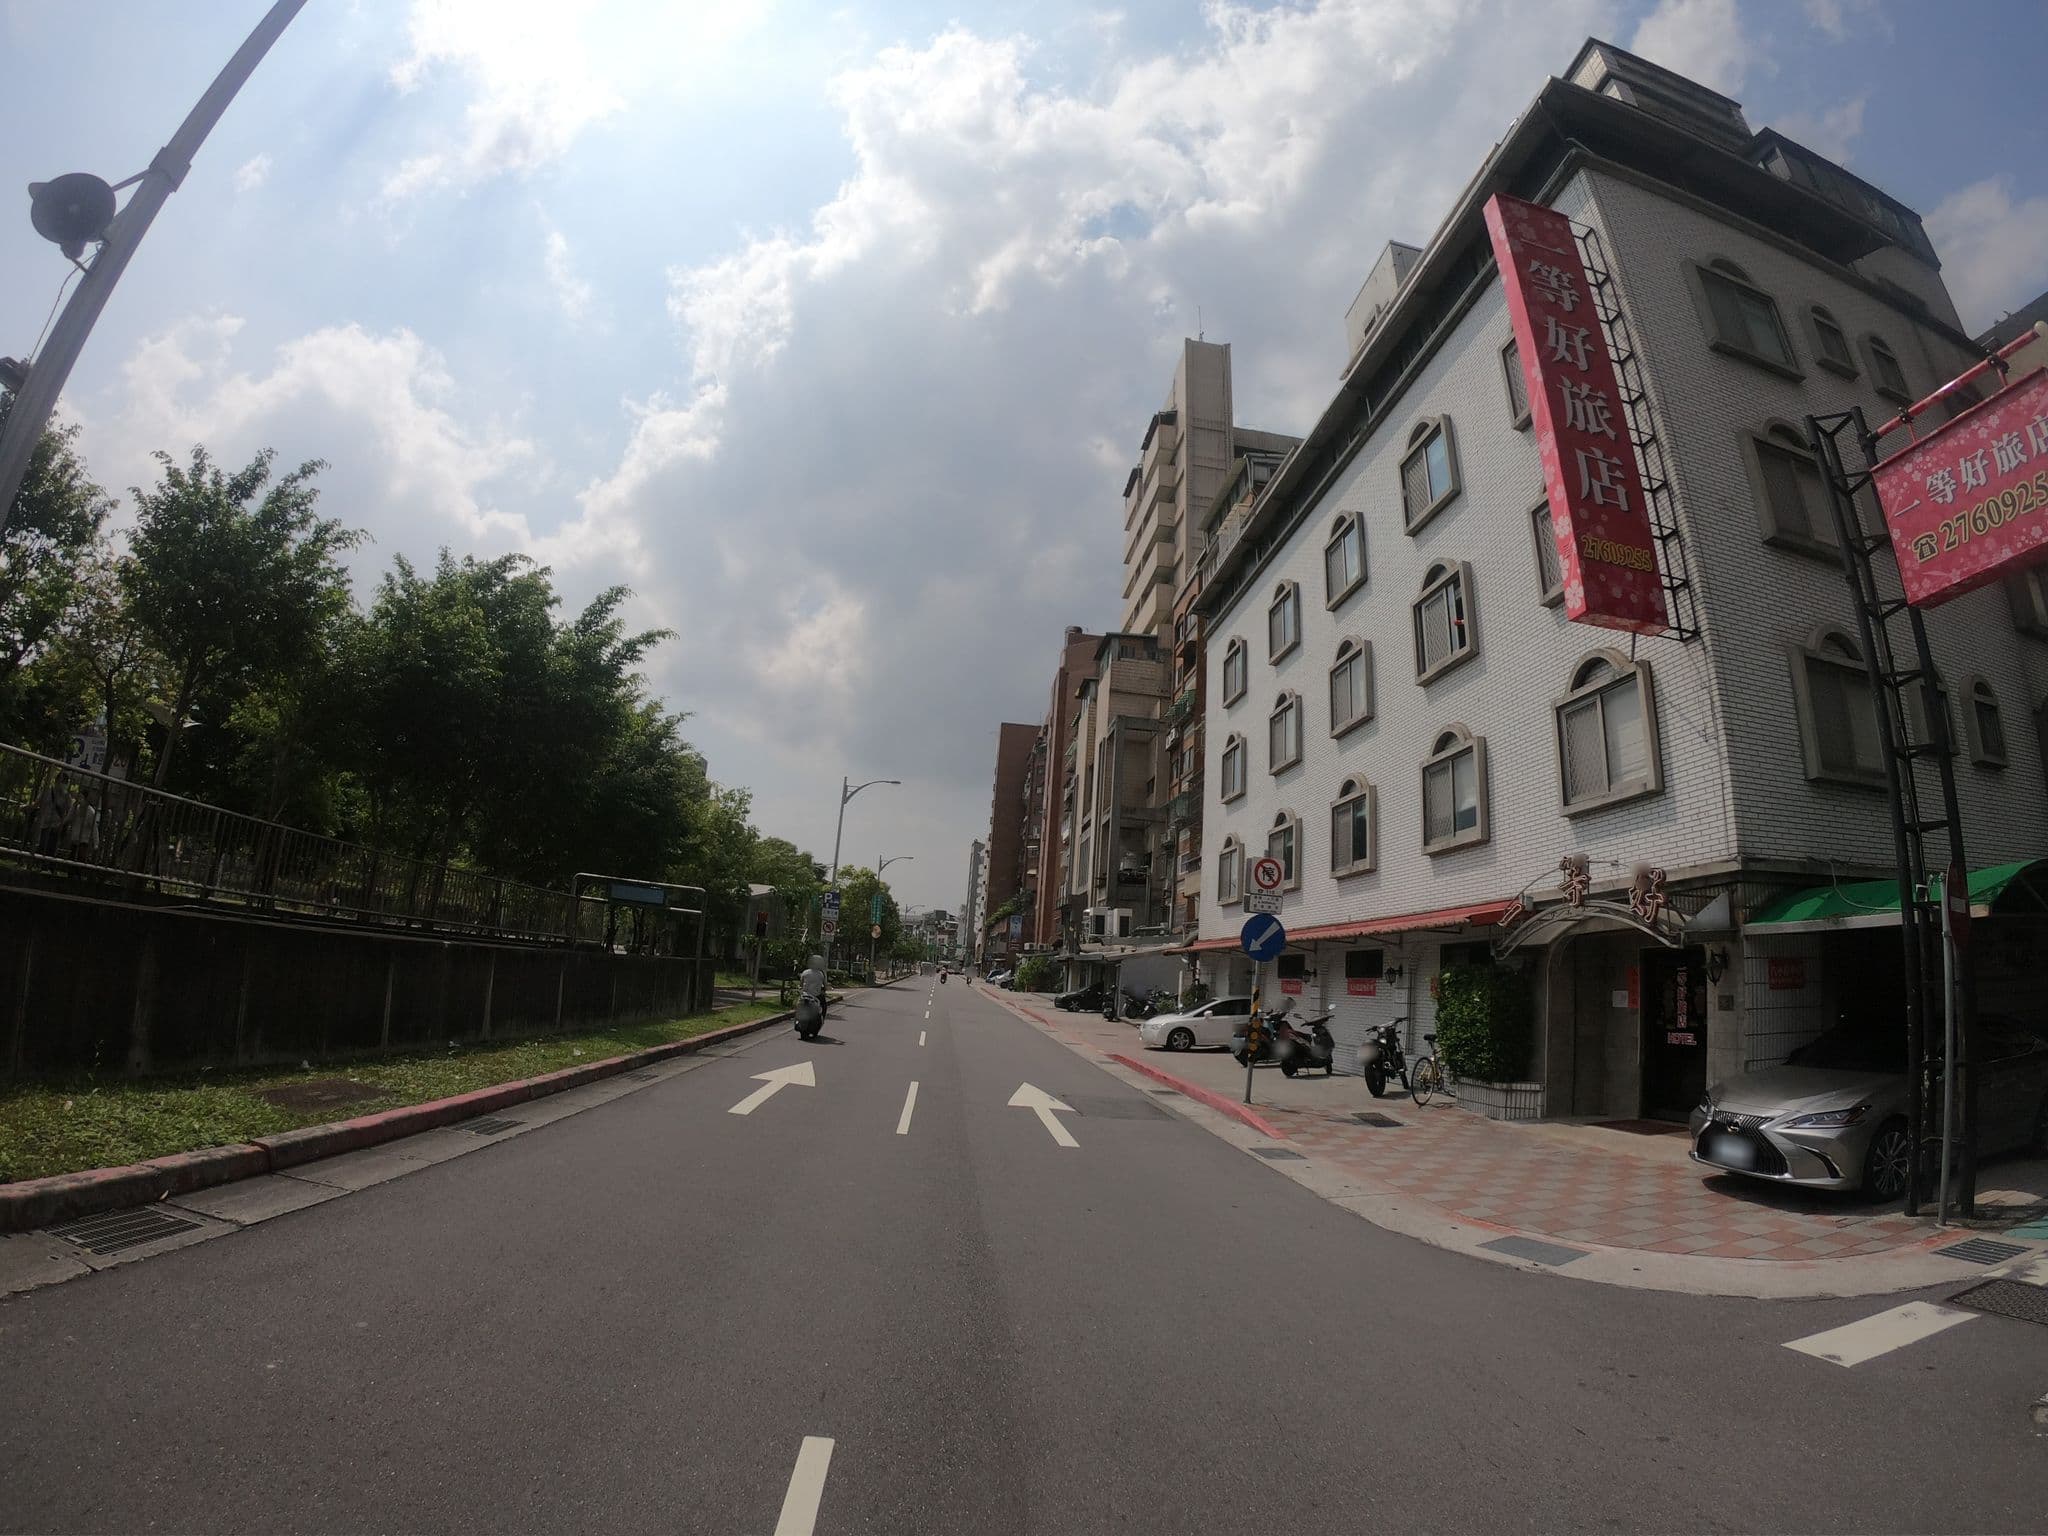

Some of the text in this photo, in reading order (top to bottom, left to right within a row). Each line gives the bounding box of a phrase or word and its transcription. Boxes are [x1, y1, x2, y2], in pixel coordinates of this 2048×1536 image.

[1520, 239, 1630, 512] 一等好旅店
[1581, 534, 1653, 573] 27609255
[1667, 1032, 1697, 1046] HOTEL
